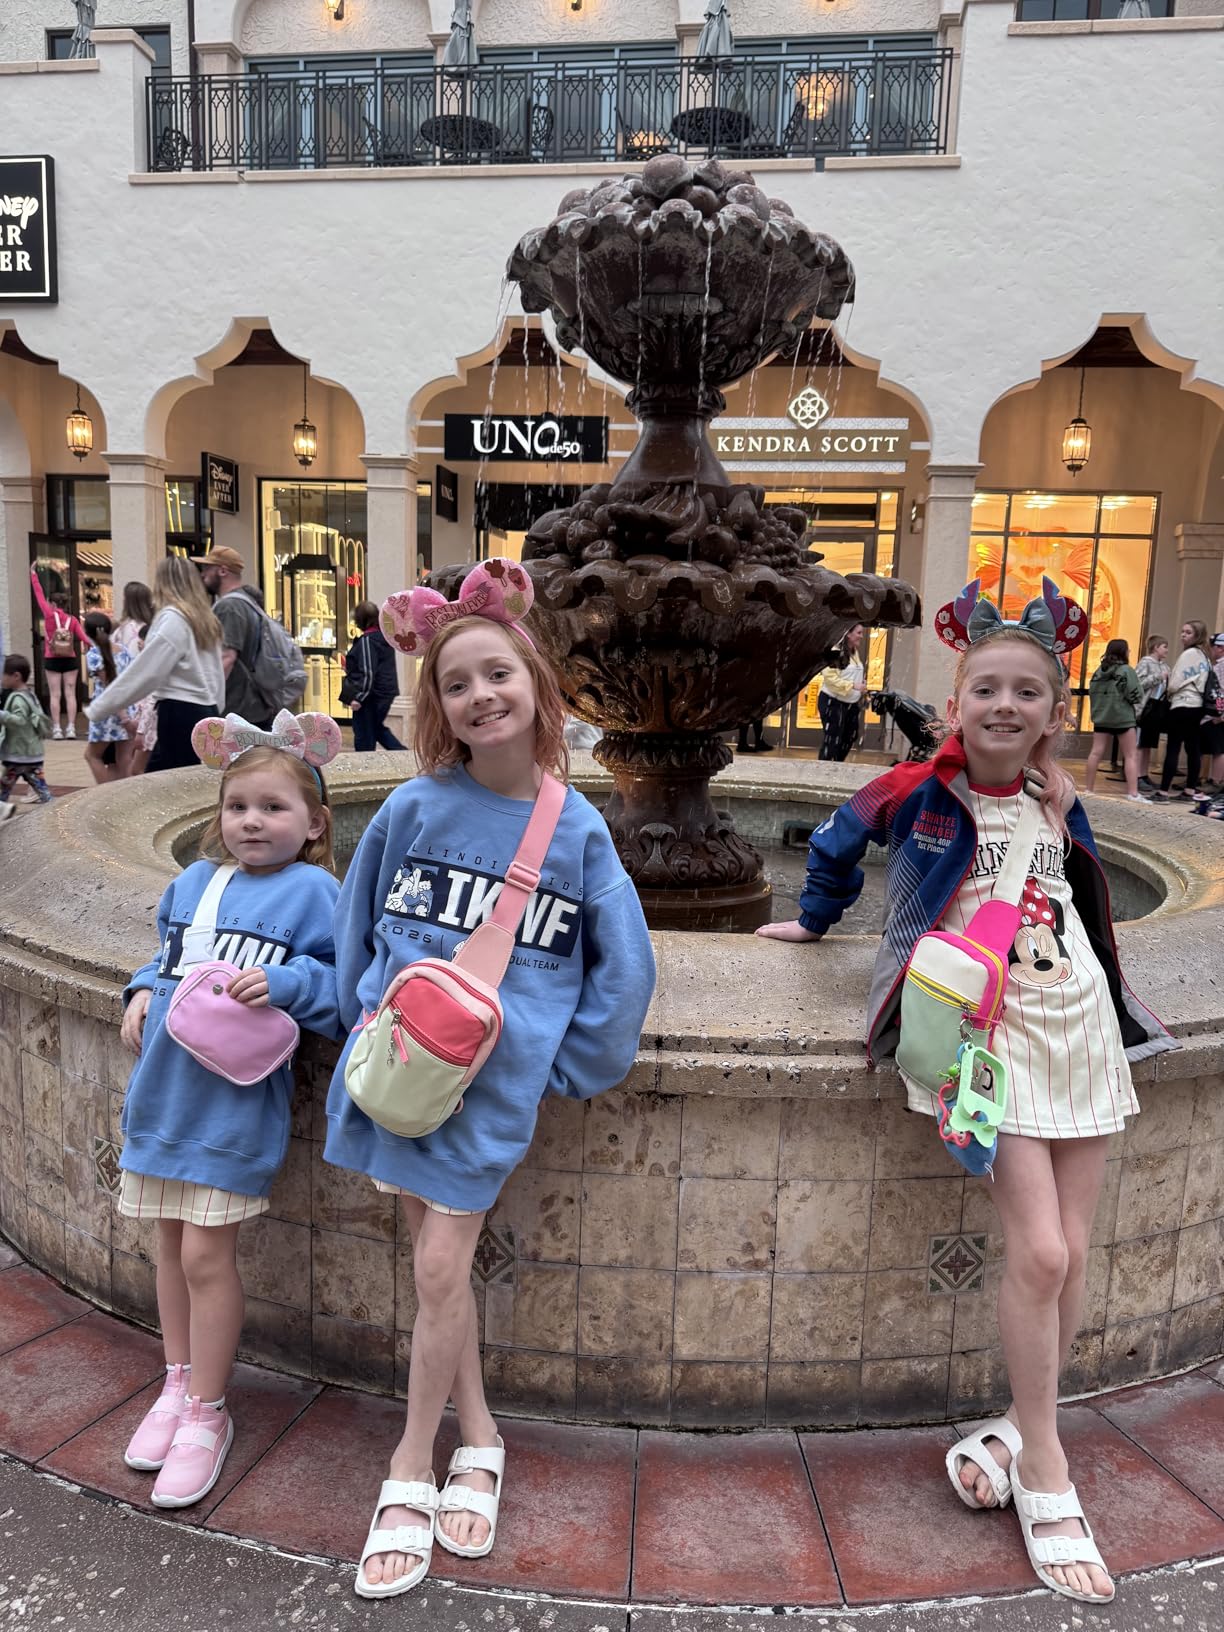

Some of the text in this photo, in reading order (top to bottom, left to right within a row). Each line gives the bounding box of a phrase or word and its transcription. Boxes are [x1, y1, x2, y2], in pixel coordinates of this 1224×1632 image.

[717, 436, 899, 454] KENDRA SCOTT
[213, 481, 230, 493] EVER
[212, 490, 232, 503] AFTER
[533, 959, 560, 971] TEAM
